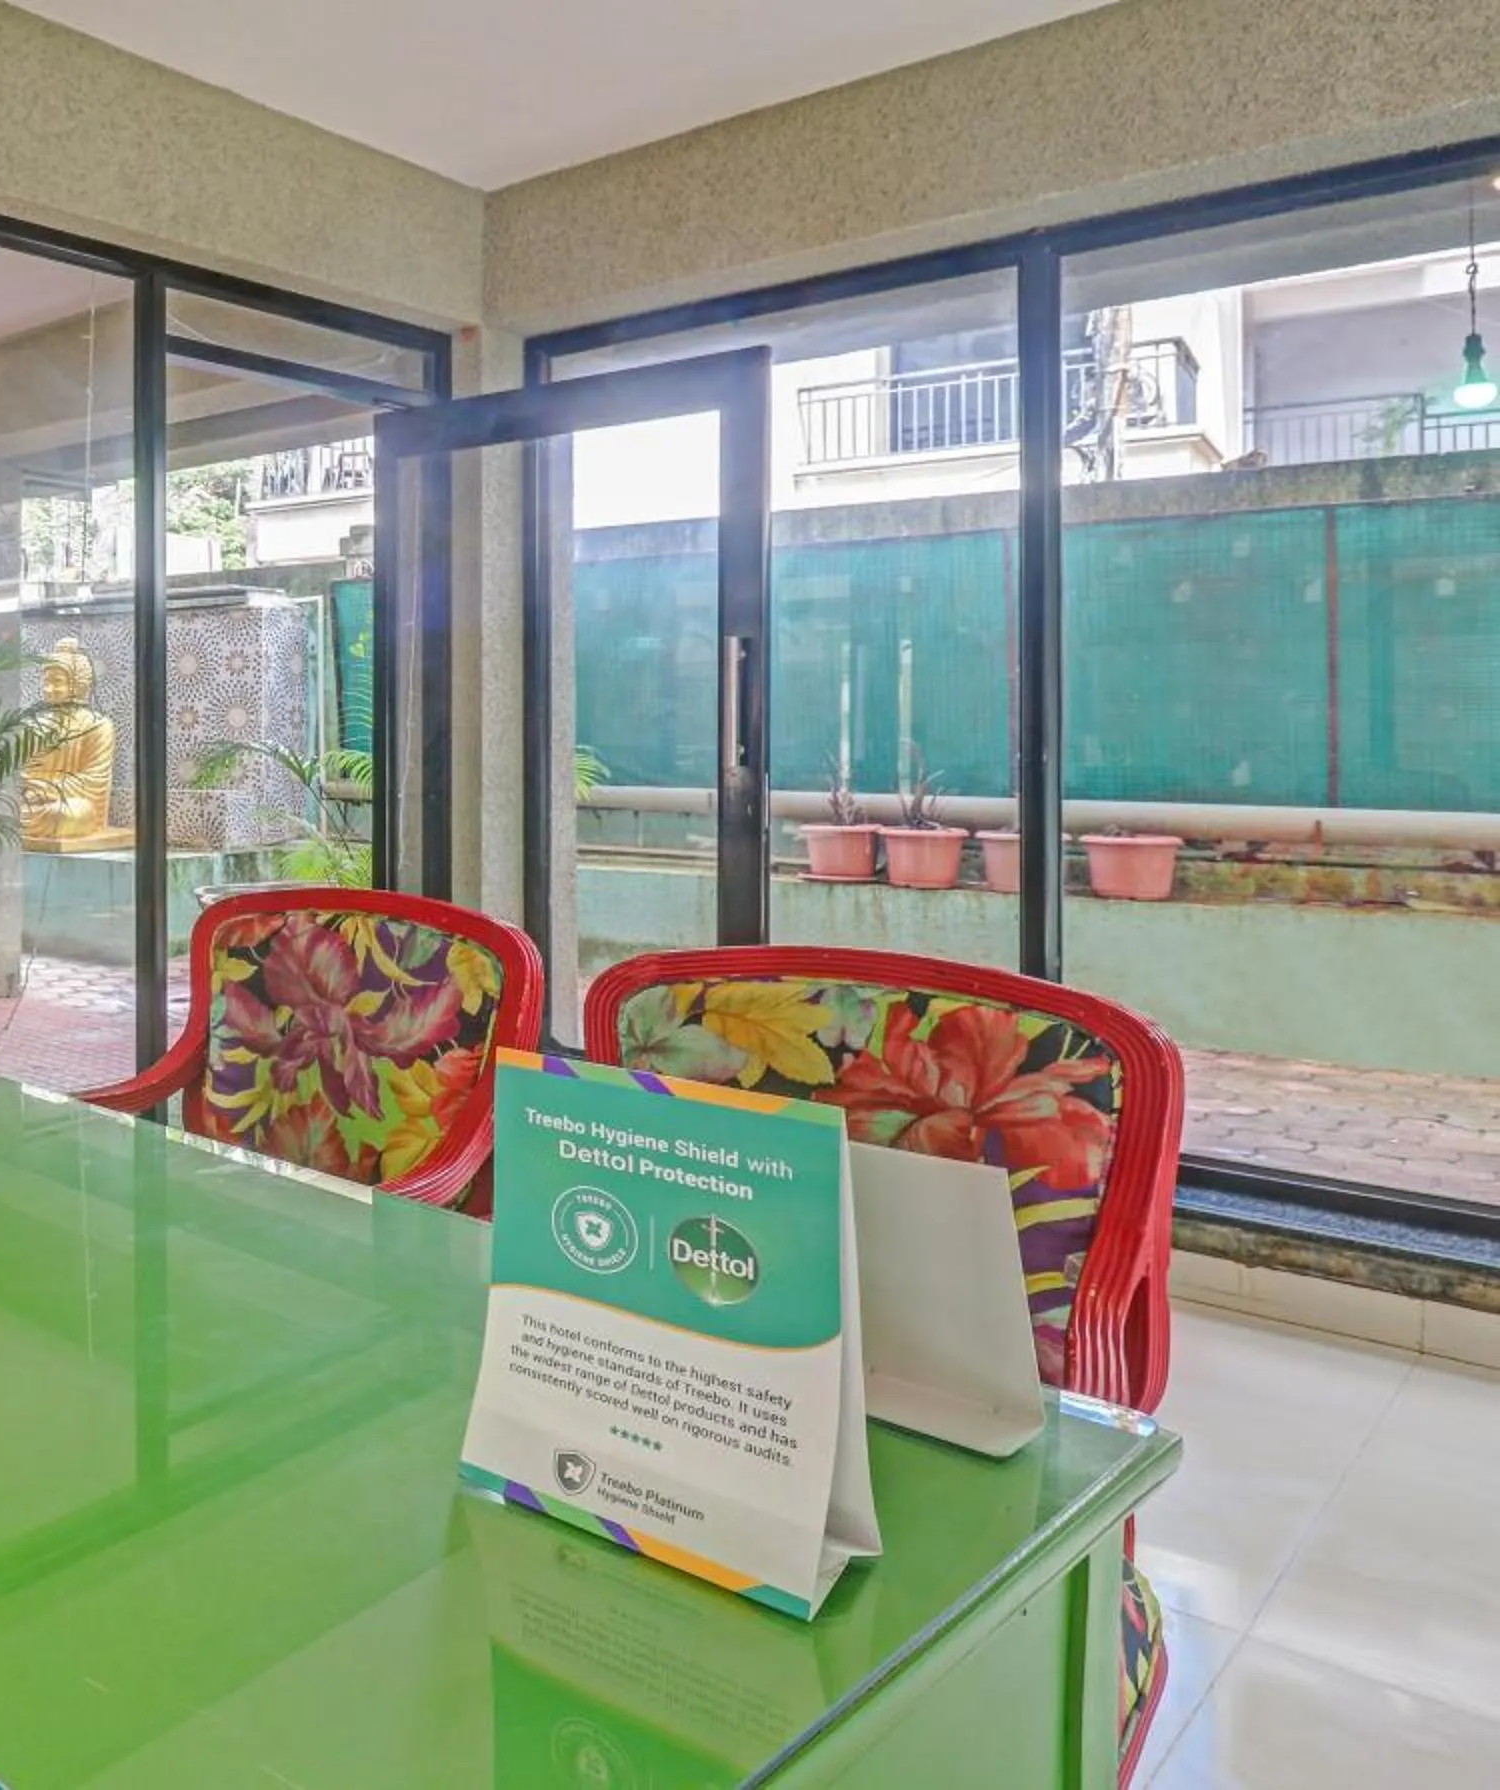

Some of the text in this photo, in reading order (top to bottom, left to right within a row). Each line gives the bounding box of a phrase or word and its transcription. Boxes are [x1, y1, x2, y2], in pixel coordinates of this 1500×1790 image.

[525, 1106, 793, 1180] Treebo Hygiene Shield with
[559, 1139, 753, 1200] Dettol Protection
[673, 1237, 755, 1281] Dettol
[511, 1344, 798, 1449] the widest range of Dettol products and has
[521, 1332, 543, 1347] and
[546, 1338, 595, 1363] hygiene
[597, 1357, 663, 1386] standards
[665, 1379, 681, 1391] of
[739, 1400, 749, 1415] It
[752, 1407, 787, 1427] uses
[522, 1314, 793, 1411] This hotel conforms to the highest safety
[509, 1361, 583, 1398] consistently
[585, 1387, 629, 1410] scored
[631, 1403, 659, 1420] well
[661, 1414, 679, 1428] on
[681, 1420, 741, 1449] rigorous
[597, 1487, 676, 1525] Hygiene Shield
[600, 1472, 705, 1521] Treebo Platinum
